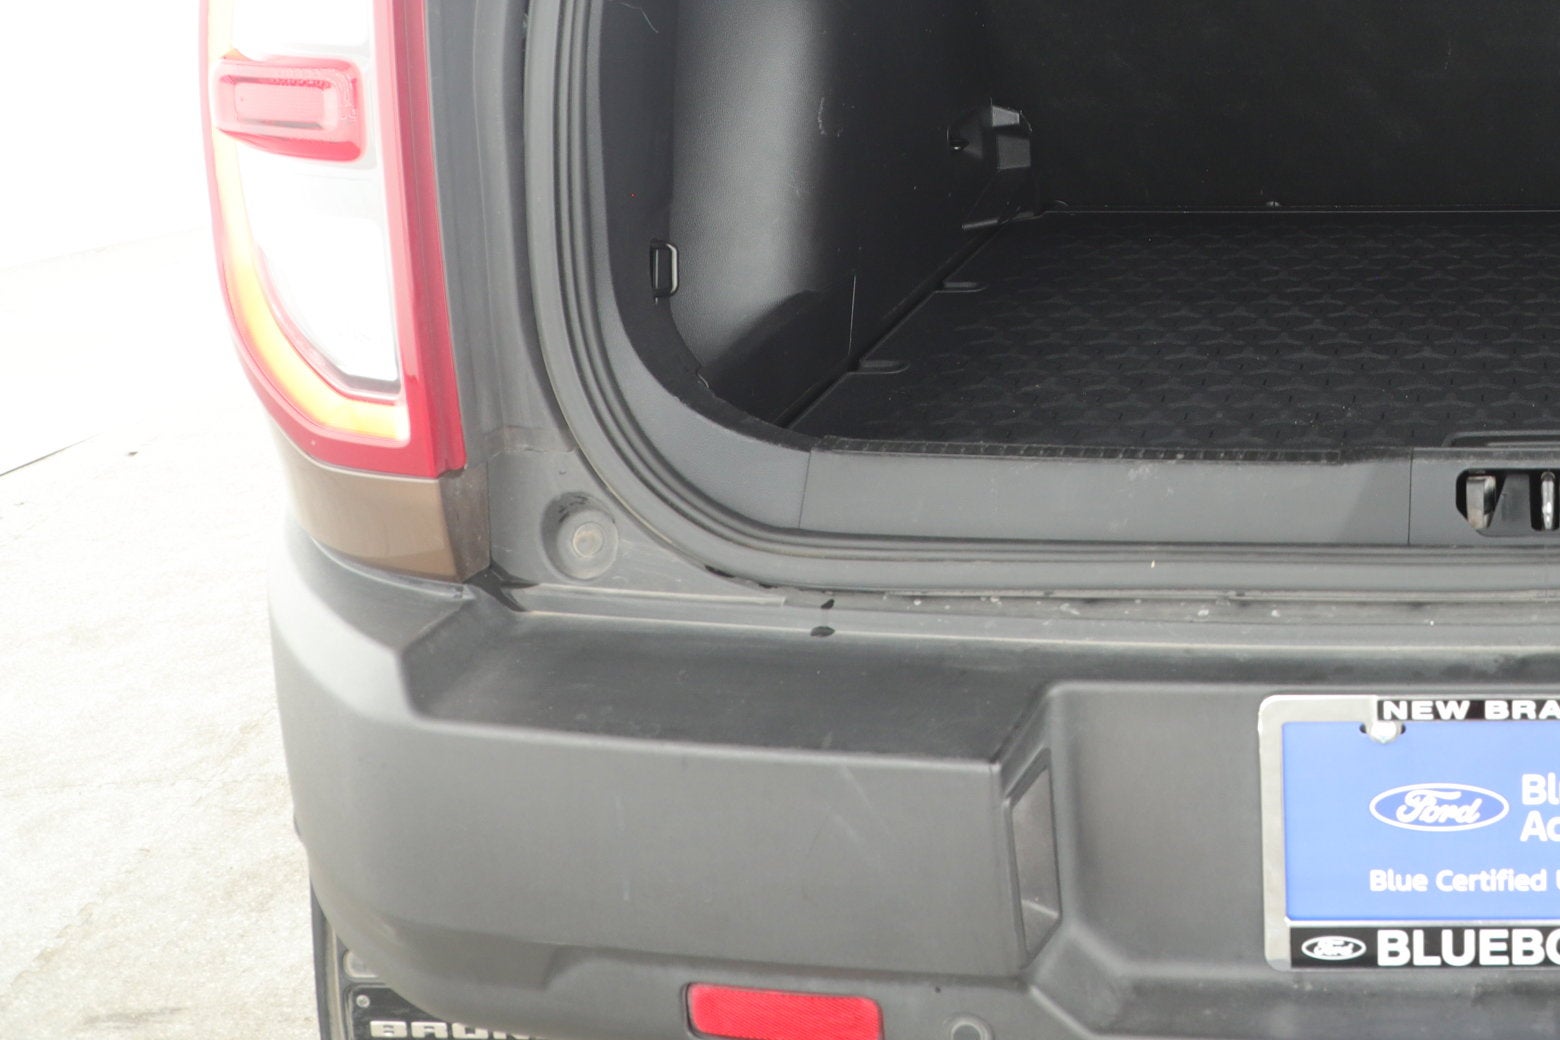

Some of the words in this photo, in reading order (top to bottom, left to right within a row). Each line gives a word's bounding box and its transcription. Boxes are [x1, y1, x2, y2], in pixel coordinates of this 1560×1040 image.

[1382, 700, 1470, 720] NEW
[1395, 788, 1483, 824] Ford
[1370, 868, 1429, 892] Blue
[1436, 868, 1547, 892] Certified
